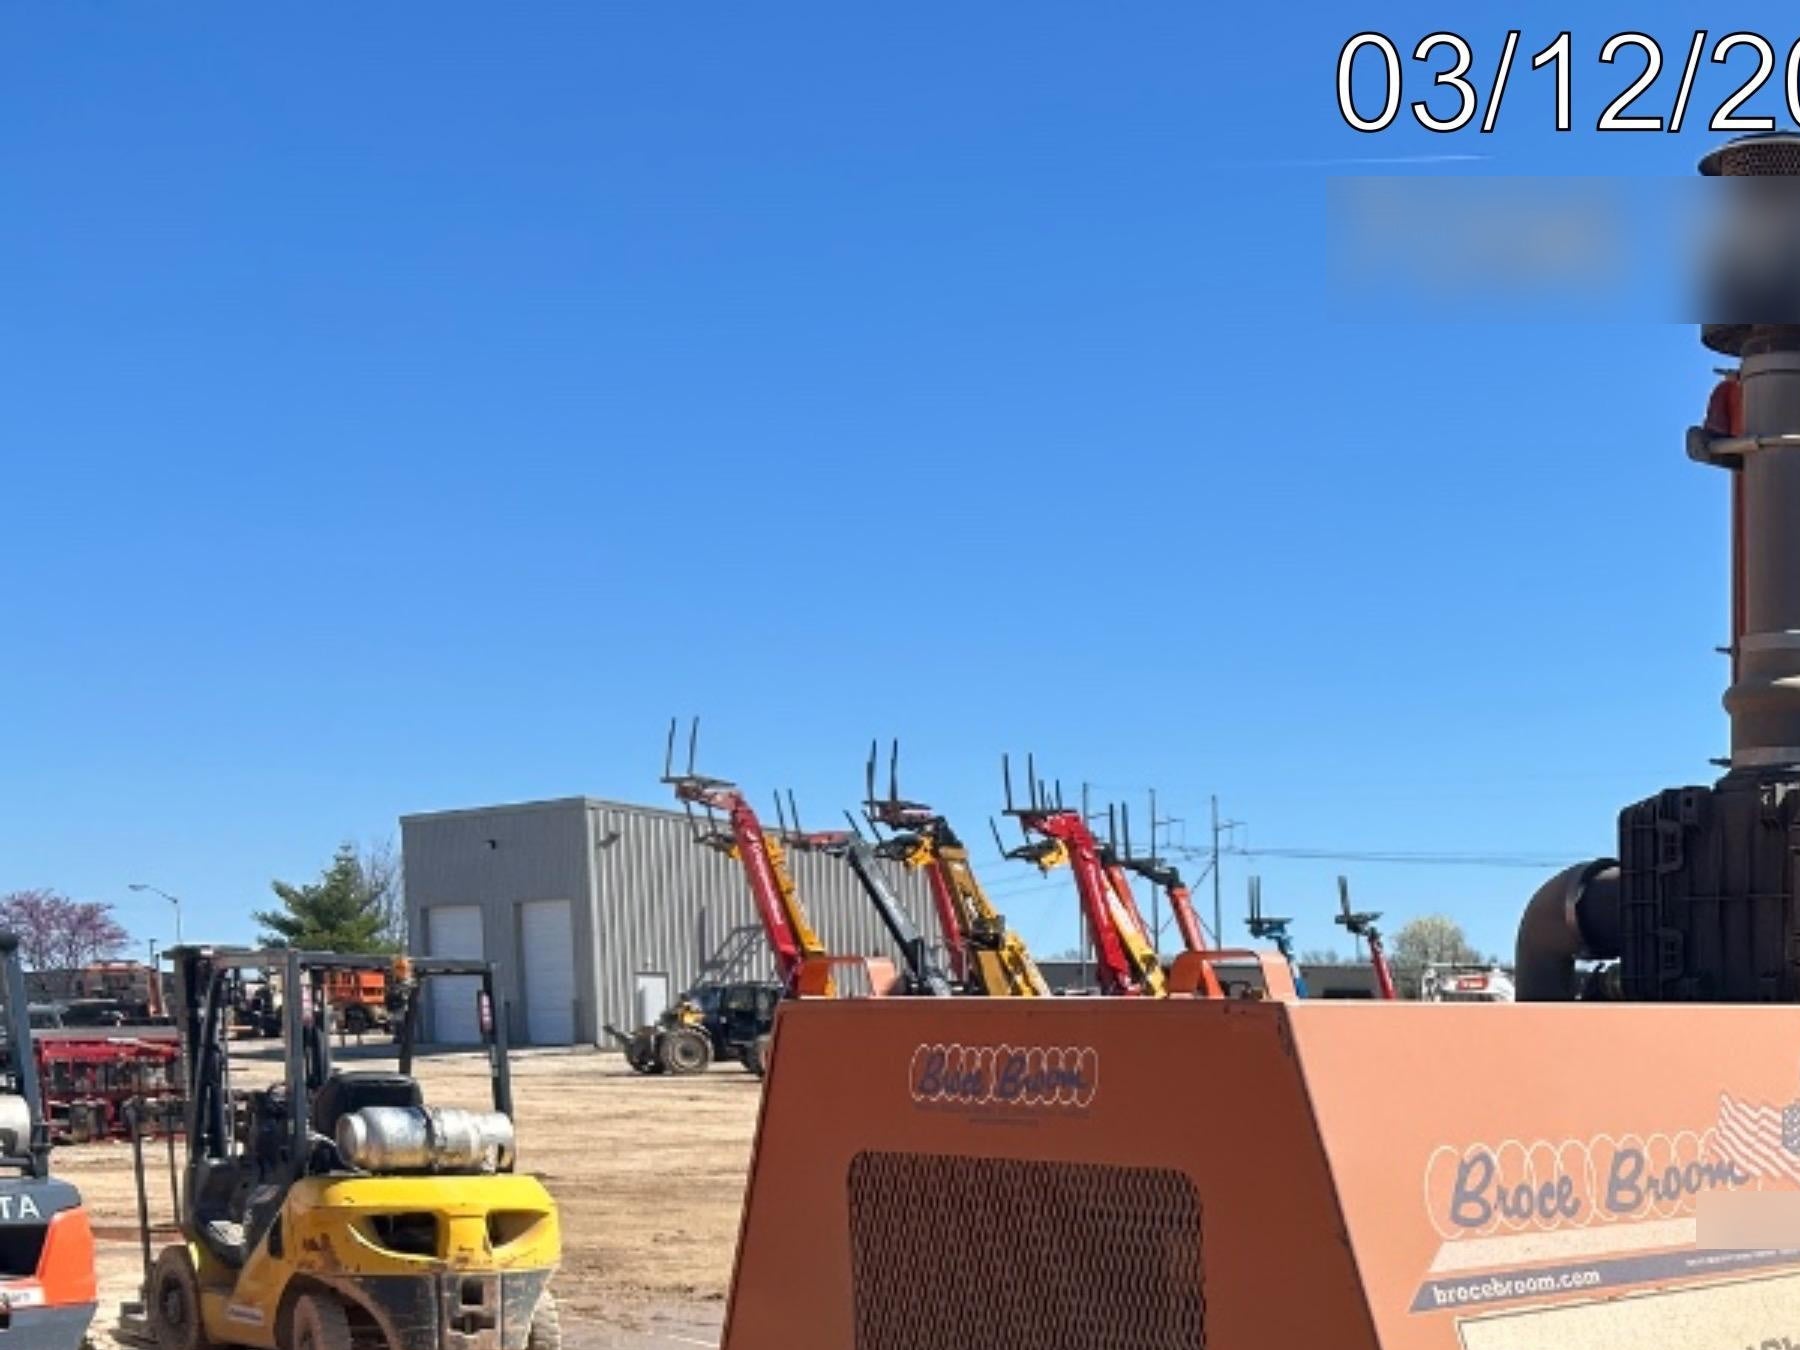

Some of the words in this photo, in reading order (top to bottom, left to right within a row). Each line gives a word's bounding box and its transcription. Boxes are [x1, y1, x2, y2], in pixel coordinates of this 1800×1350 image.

[1449, 1150, 1581, 1228] Broce
[1604, 1148, 1749, 1214] Broom
[1432, 1267, 1601, 1305] brocebroom.com
